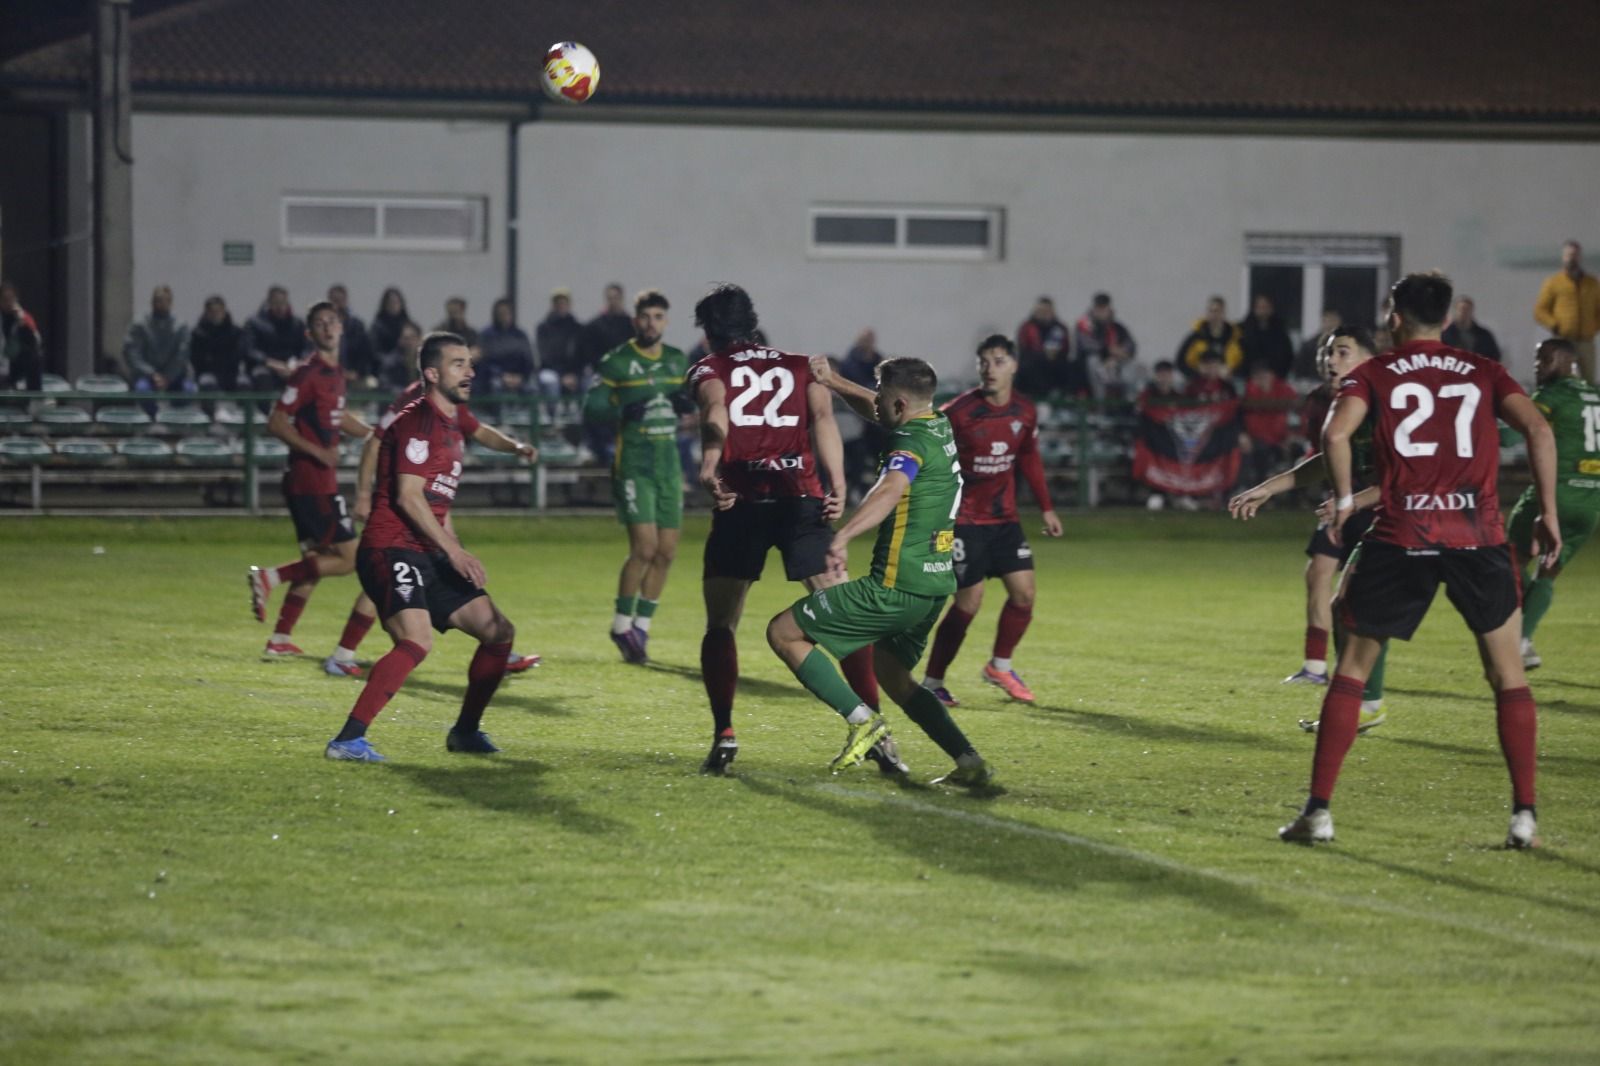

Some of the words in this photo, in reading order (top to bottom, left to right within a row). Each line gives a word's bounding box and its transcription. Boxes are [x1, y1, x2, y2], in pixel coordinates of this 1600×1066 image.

[1386, 353, 1476, 376] TAMARIT
[729, 365, 800, 427] 22
[1390, 382, 1482, 458] 27
[888, 456, 904, 470] C
[1404, 492, 1476, 511] IZADI
[952, 538, 966, 562] 8
[393, 562, 425, 587] 21
